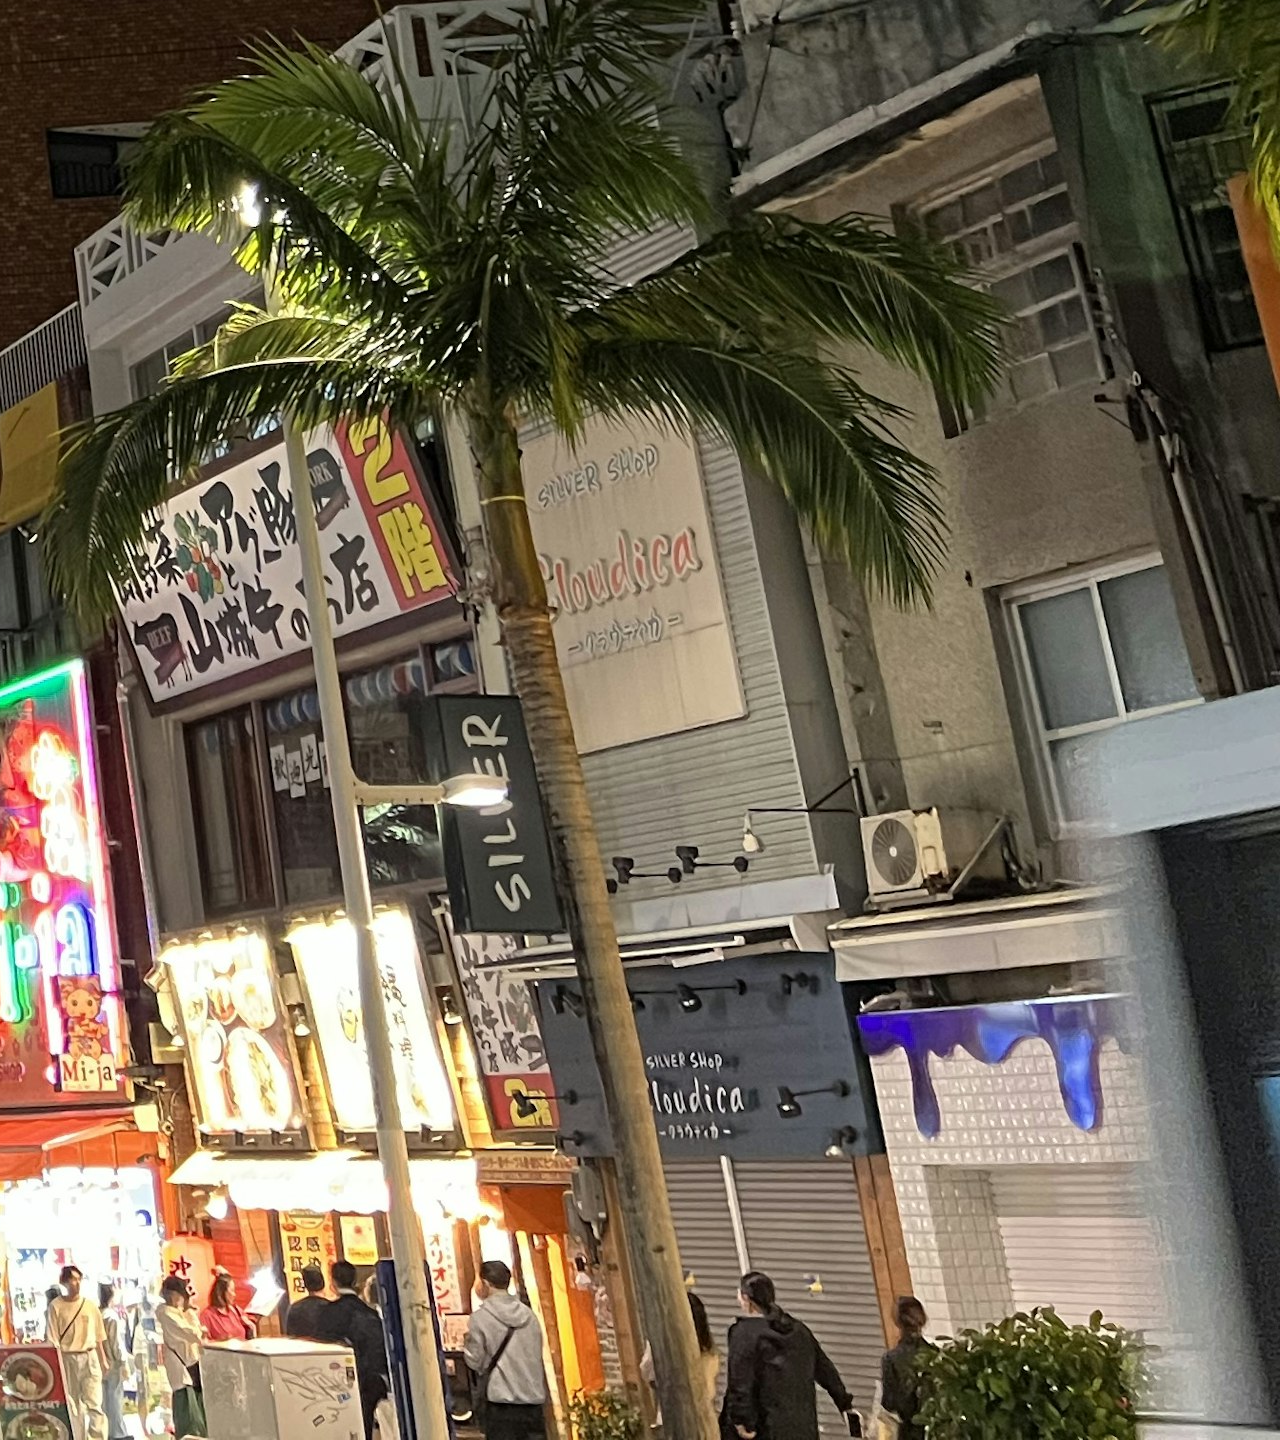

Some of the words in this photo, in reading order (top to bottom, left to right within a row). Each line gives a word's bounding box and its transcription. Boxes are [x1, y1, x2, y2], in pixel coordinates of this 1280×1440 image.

[309, 461, 334, 487] ORK
[538, 462, 603, 509] SILVER
[606, 442, 660, 484] SHOP
[348, 413, 448, 599] 2階
[146, 624, 173, 650] BEEF
[62, 1059, 113, 1091] Mi-ja
[646, 1051, 686, 1069] SILVER
[689, 1050, 723, 1073] SHOP
[651, 1076, 745, 1114] loudica
